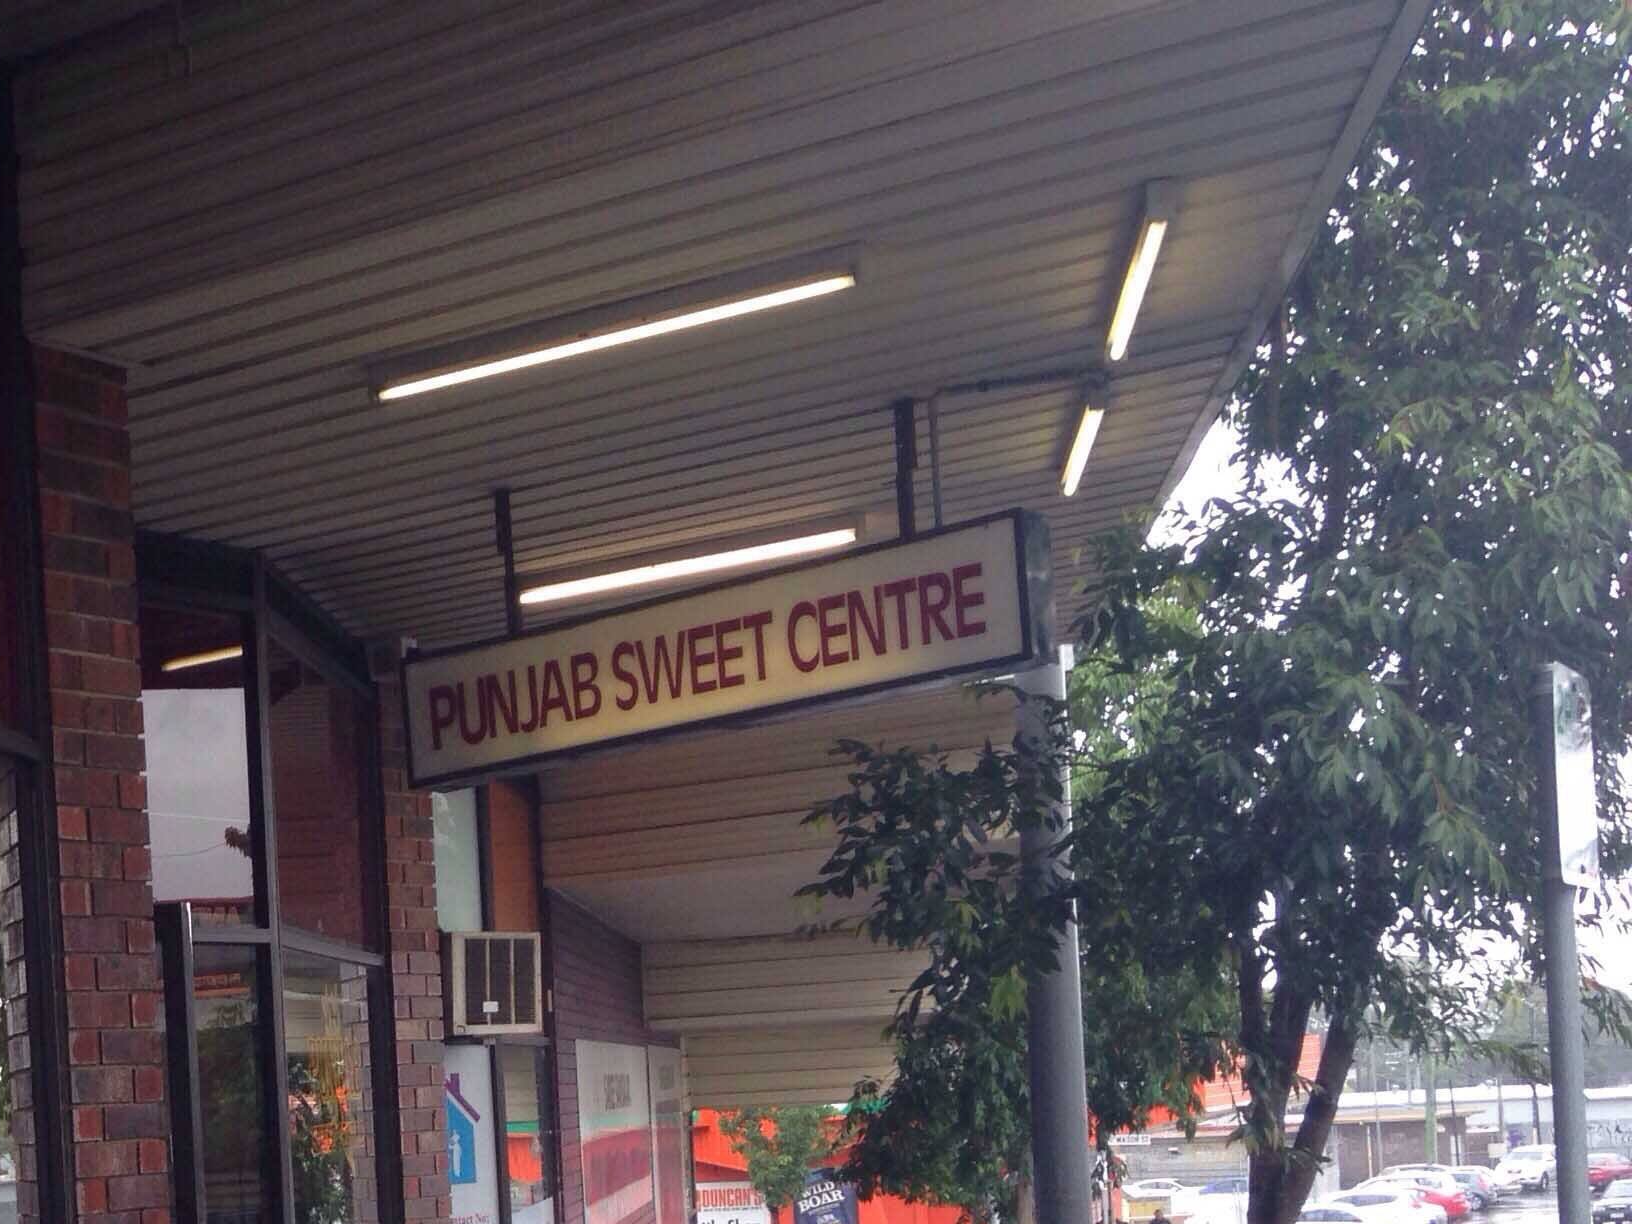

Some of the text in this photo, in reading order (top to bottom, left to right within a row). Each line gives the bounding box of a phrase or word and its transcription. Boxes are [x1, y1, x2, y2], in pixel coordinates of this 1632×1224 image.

[427, 562, 988, 751] PUNJAB SWEET CENTRE
[798, 1189, 845, 1213] BOAR
[802, 1181, 835, 1198] WILD
